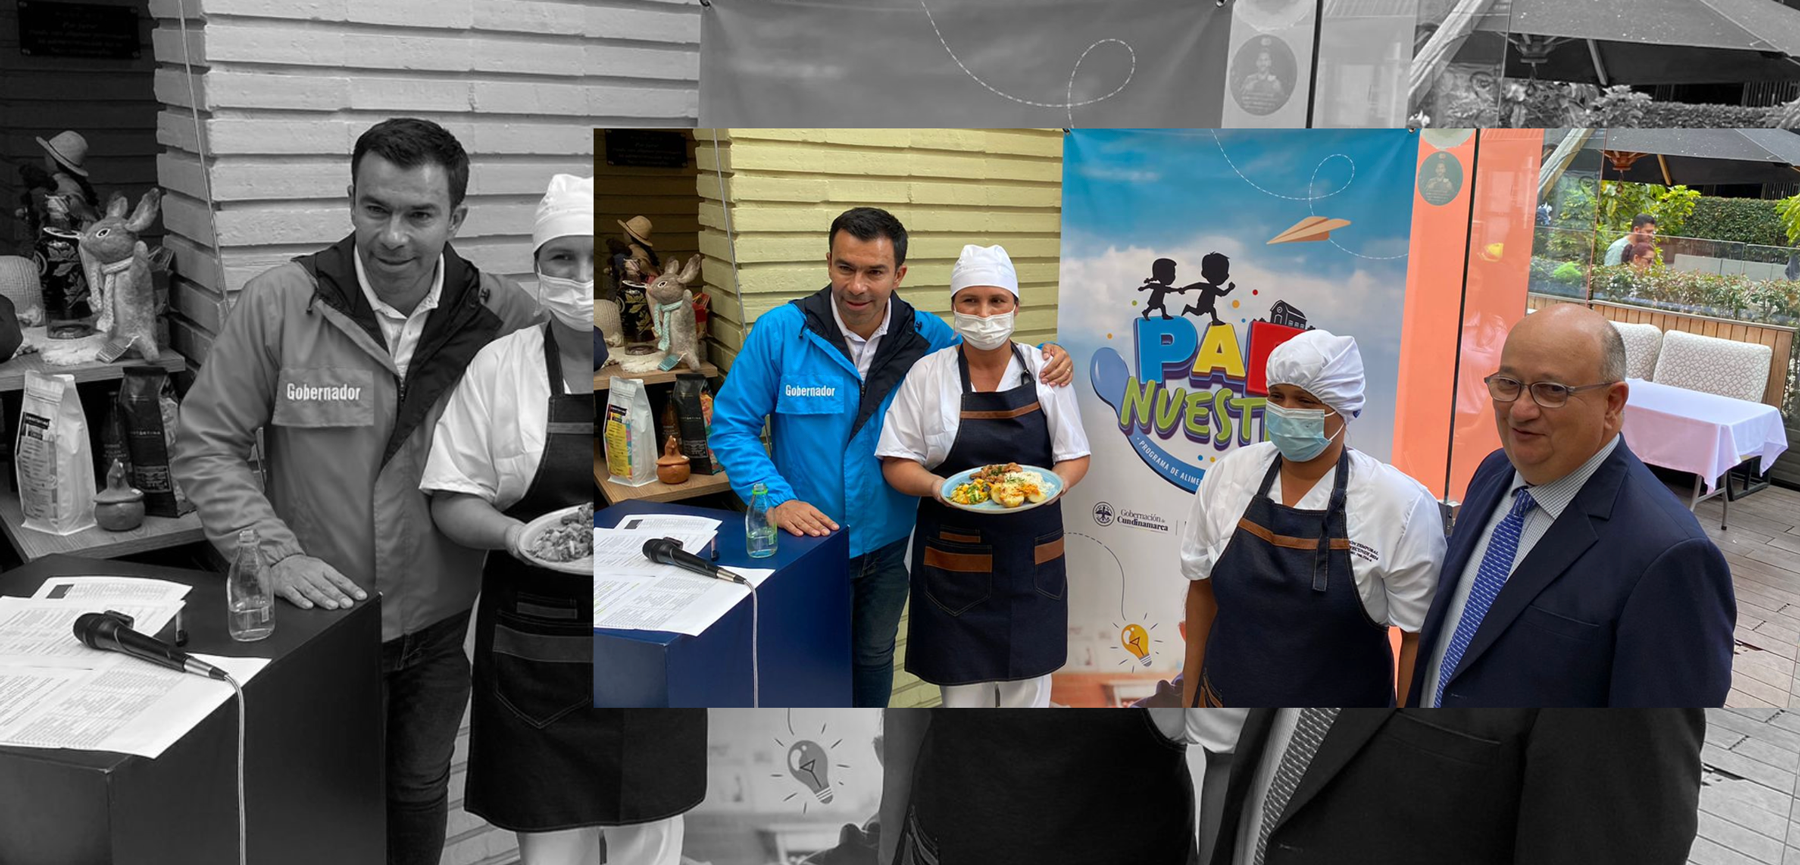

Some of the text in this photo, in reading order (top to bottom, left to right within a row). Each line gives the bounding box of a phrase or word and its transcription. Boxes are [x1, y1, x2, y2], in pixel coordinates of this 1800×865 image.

[286, 382, 361, 401] Gobernador
[785, 384, 836, 398] Gobernador
[1119, 375, 1268, 450] NUEST
[1138, 440, 1201, 486] PROGRAMA DE ALIME
[1116, 515, 1169, 531] Cundinamarca
[1120, 508, 1161, 523] Gobernación
